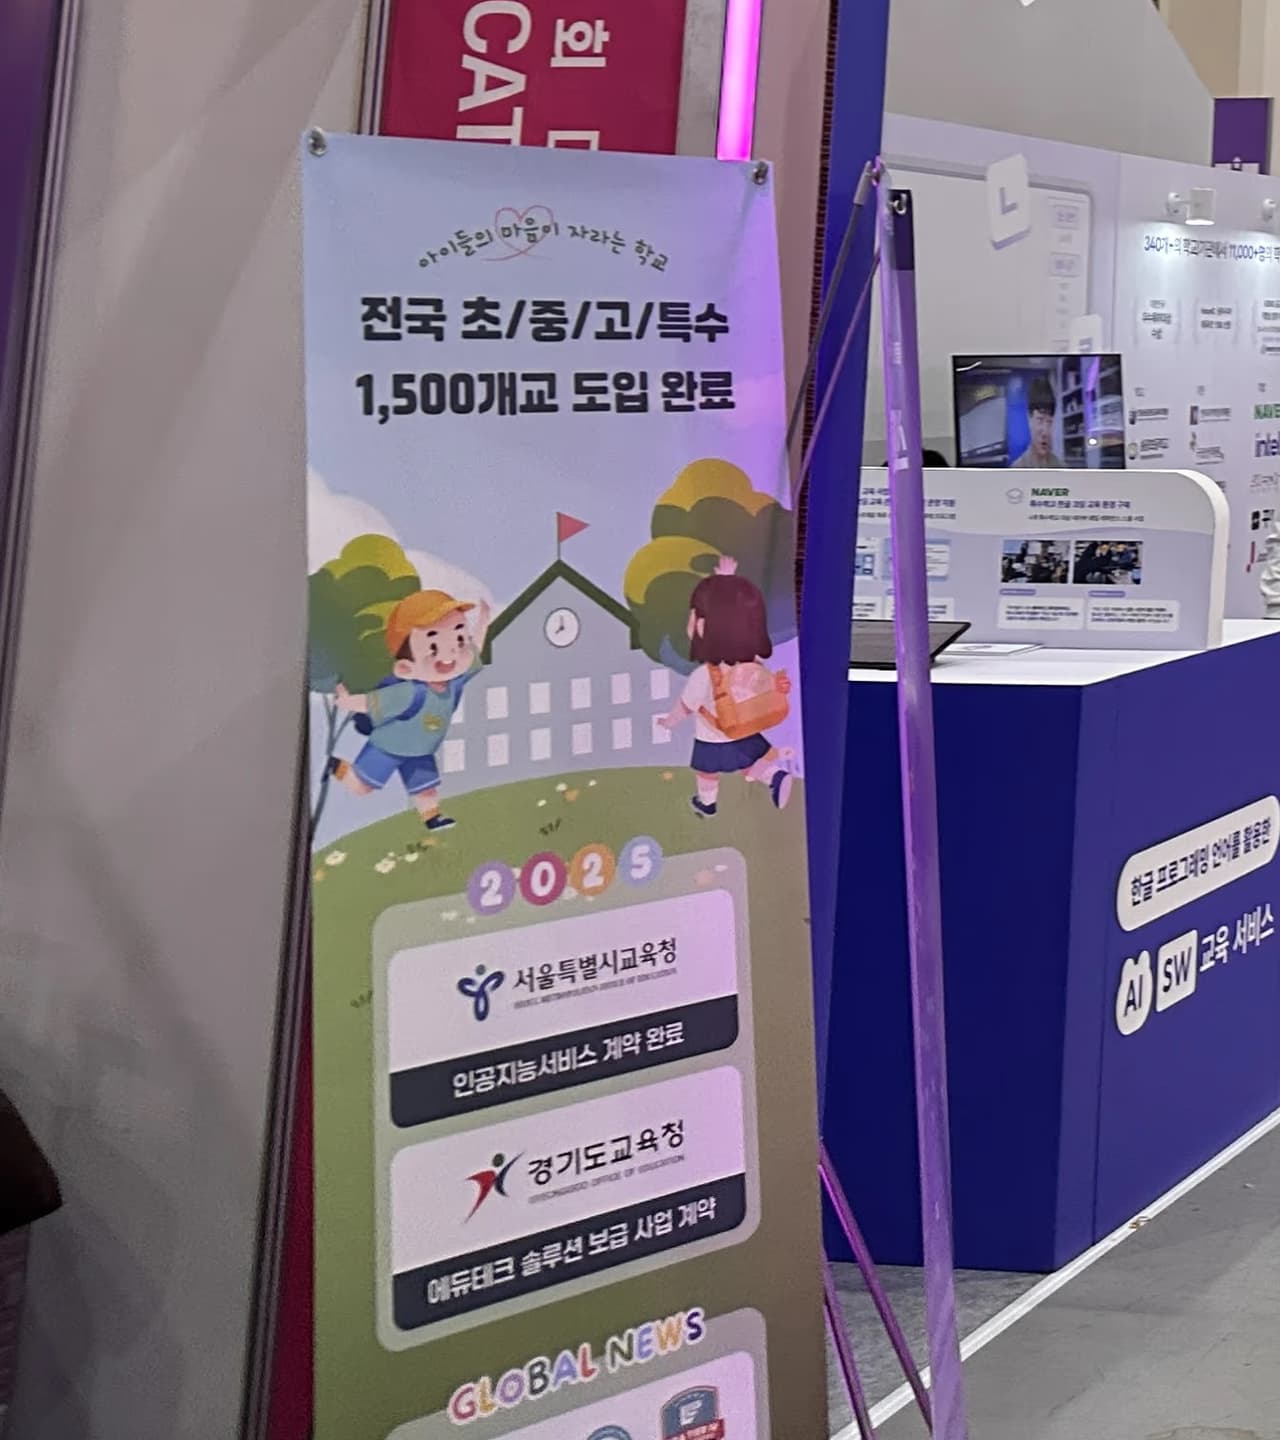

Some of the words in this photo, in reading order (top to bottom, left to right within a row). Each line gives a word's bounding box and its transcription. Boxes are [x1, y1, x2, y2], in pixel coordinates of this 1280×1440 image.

[418, 228, 494, 268] 아이들의
[500, 217, 559, 243] 마음이
[567, 225, 626, 254] 자라는
[633, 238, 668, 272] 학교
[360, 295, 447, 344] 전국
[461, 296, 730, 343] 초/중/고/특수
[355, 371, 559, 425] 1,500개교
[571, 371, 648, 415] 도입
[660, 371, 737, 414] 완료
[1031, 488, 1070, 496] NAVER
[479, 841, 652, 907] 2025
[1130, 870, 1154, 907] 한글
[1156, 843, 1210, 893] 프로그래밍
[514, 937, 677, 993] 서울특별시교육청
[1123, 974, 1144, 1018] AI
[1162, 946, 1193, 993] SW
[1200, 925, 1230, 972] 교육
[1233, 903, 1275, 954] 서비스
[453, 1043, 598, 1099] 인공지능서비스
[603, 1032, 643, 1061] 계약
[646, 1021, 685, 1052] 완료
[528, 1119, 684, 1186] 경기도교육청
[427, 1257, 515, 1305] 에듀테크
[521, 1238, 583, 1277] 솔루션
[588, 1222, 629, 1255] 보급
[634, 1209, 673, 1241] 사업
[678, 1197, 717, 1229] 계약
[451, 1346, 596, 1421] GLOBAL
[609, 1311, 703, 1367] NEWS
